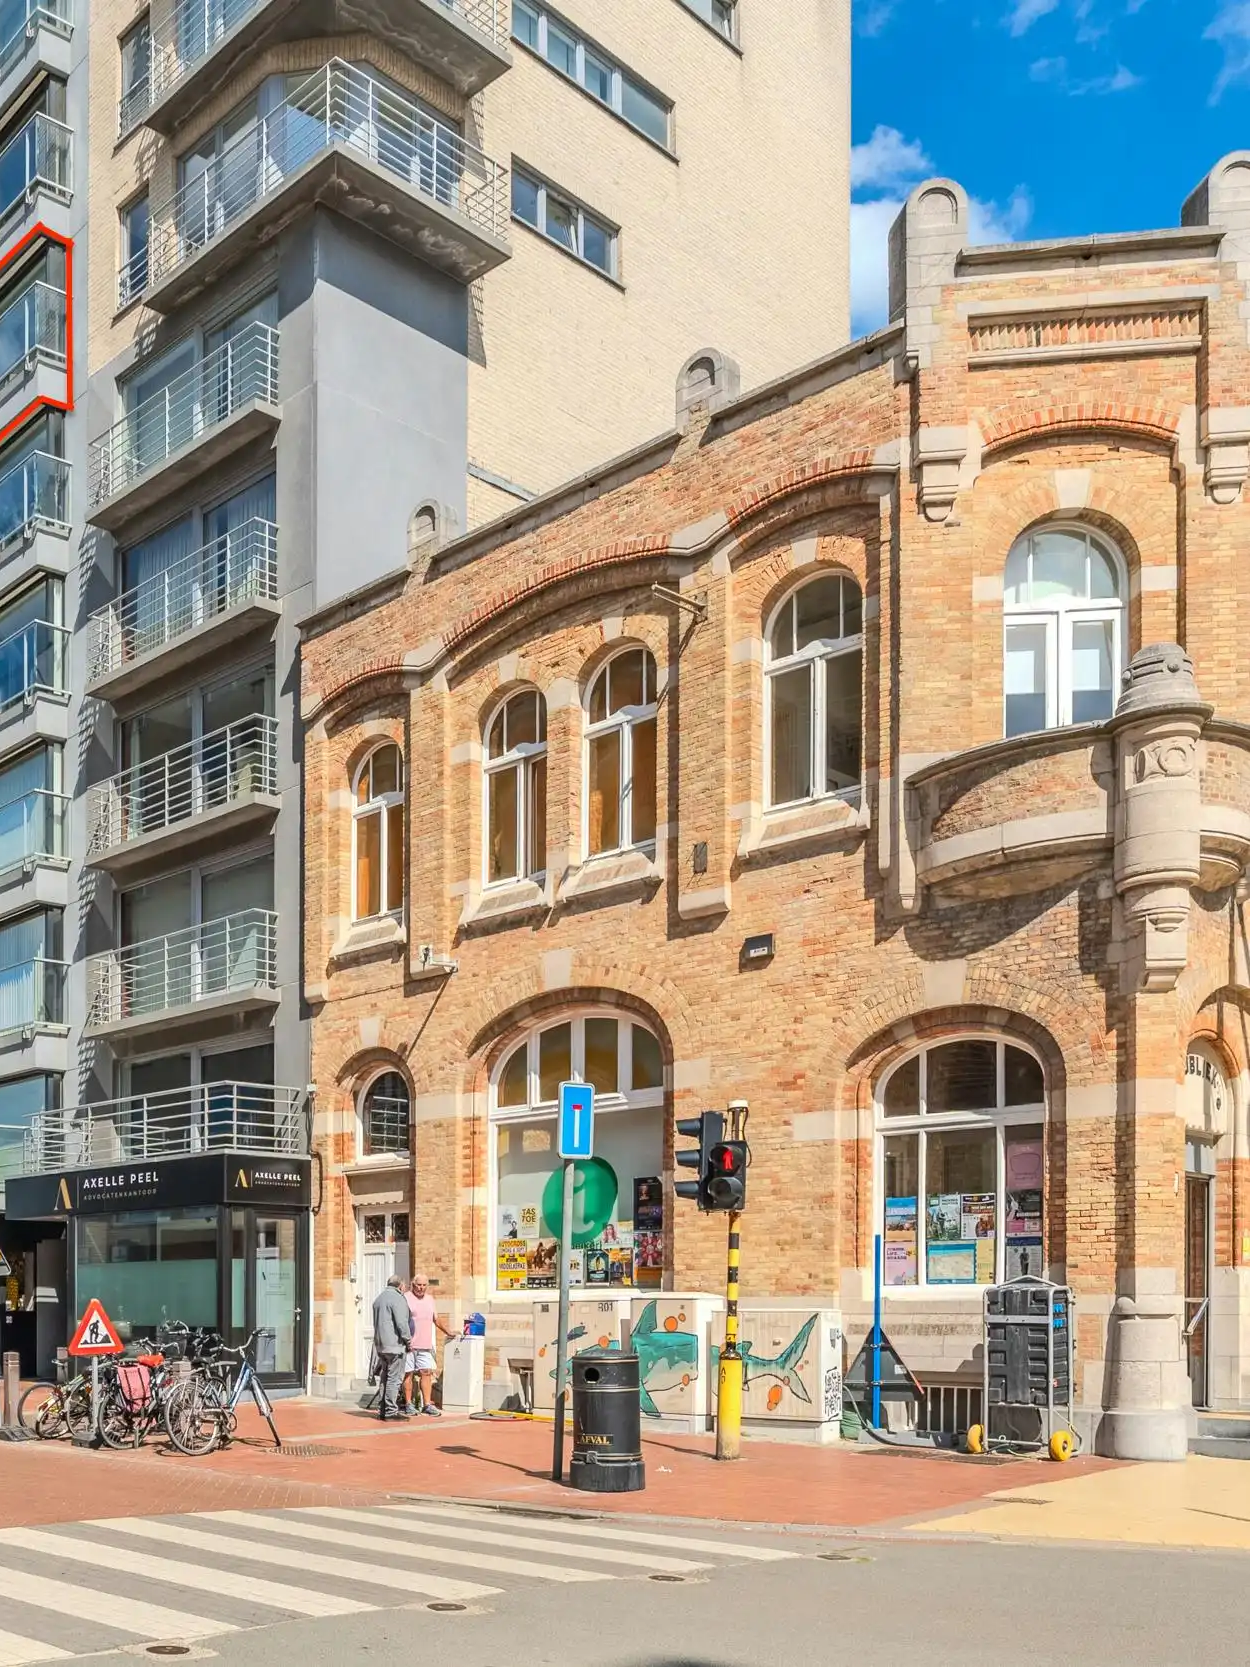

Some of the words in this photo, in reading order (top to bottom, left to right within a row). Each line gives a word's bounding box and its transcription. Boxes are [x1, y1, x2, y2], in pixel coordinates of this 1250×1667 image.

[83, 1175, 125, 1189] AXELLE
[130, 1171, 159, 1185] PEEL
[254, 1172, 282, 1181] AXELLE
[283, 1173, 302, 1181] PEEL
[521, 1207, 536, 1216] TAS
[521, 1215, 536, 1223] TOE
[580, 1435, 610, 1445] AFVAL
